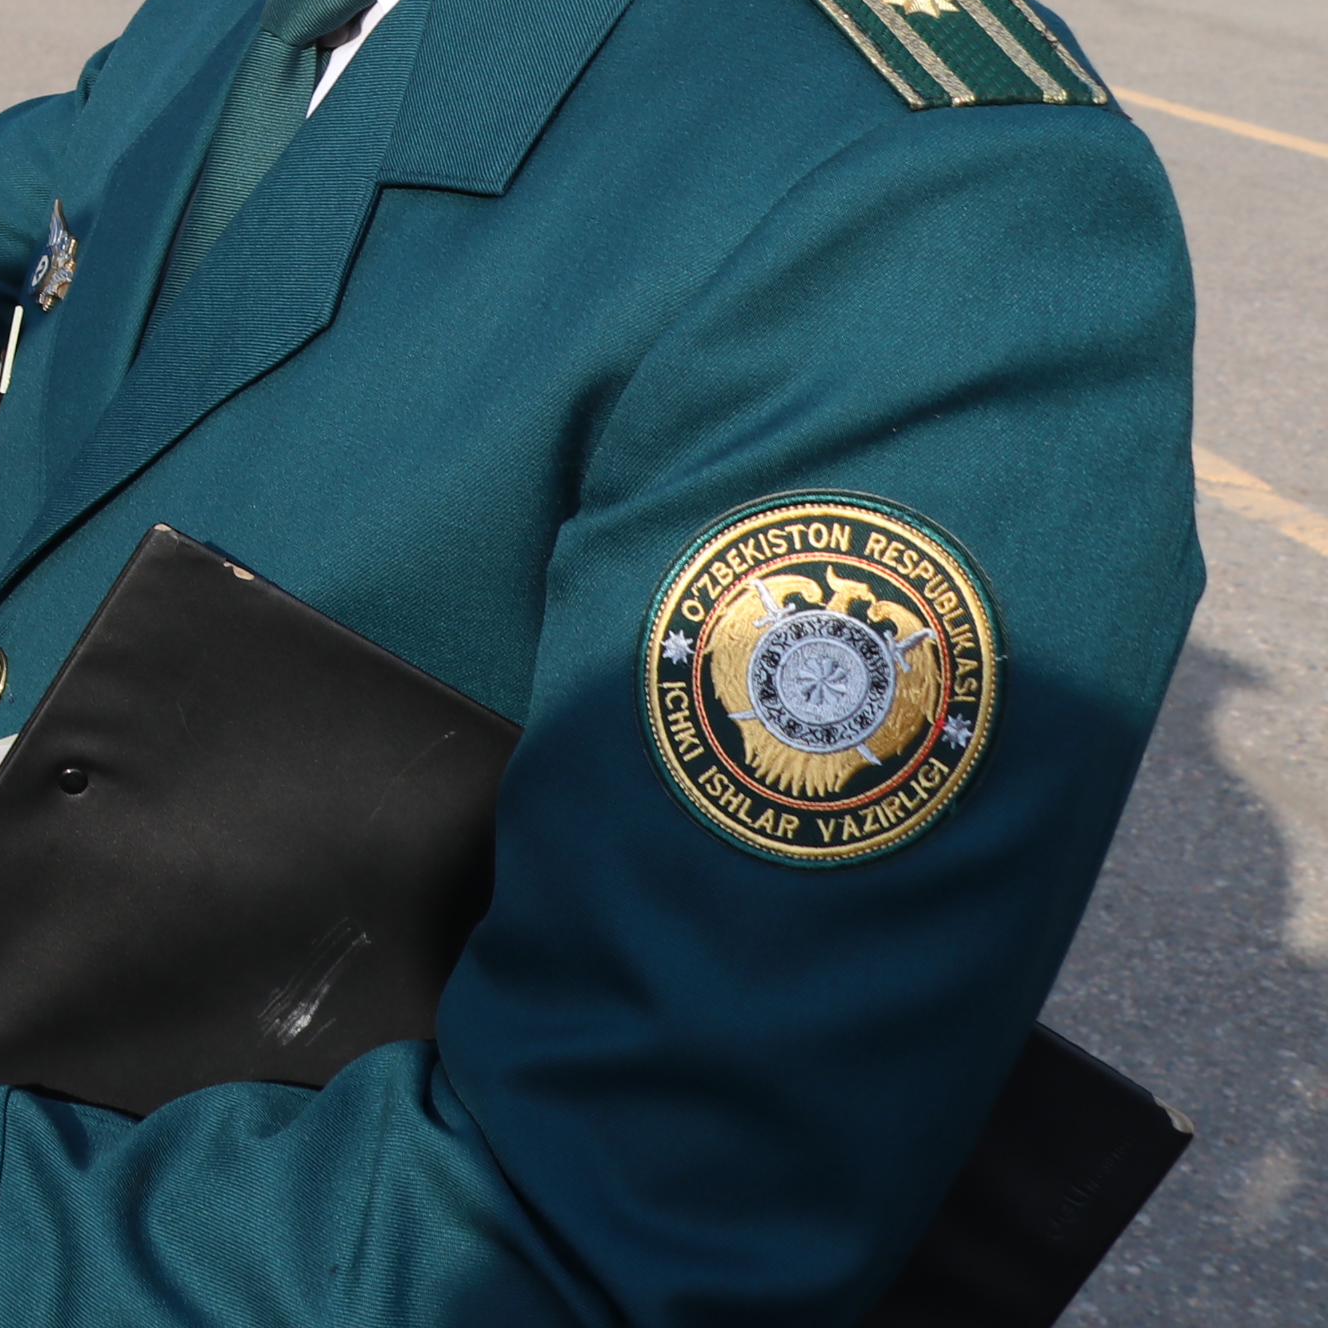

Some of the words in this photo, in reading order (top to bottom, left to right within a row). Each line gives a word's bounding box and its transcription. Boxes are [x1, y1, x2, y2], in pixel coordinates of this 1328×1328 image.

[865, 531, 979, 704] RESPUBLIKASI
[661, 680, 705, 763] ICHKI
[697, 765, 800, 840] ISHLAR
[816, 756, 951, 843] VAZIRLIGI
